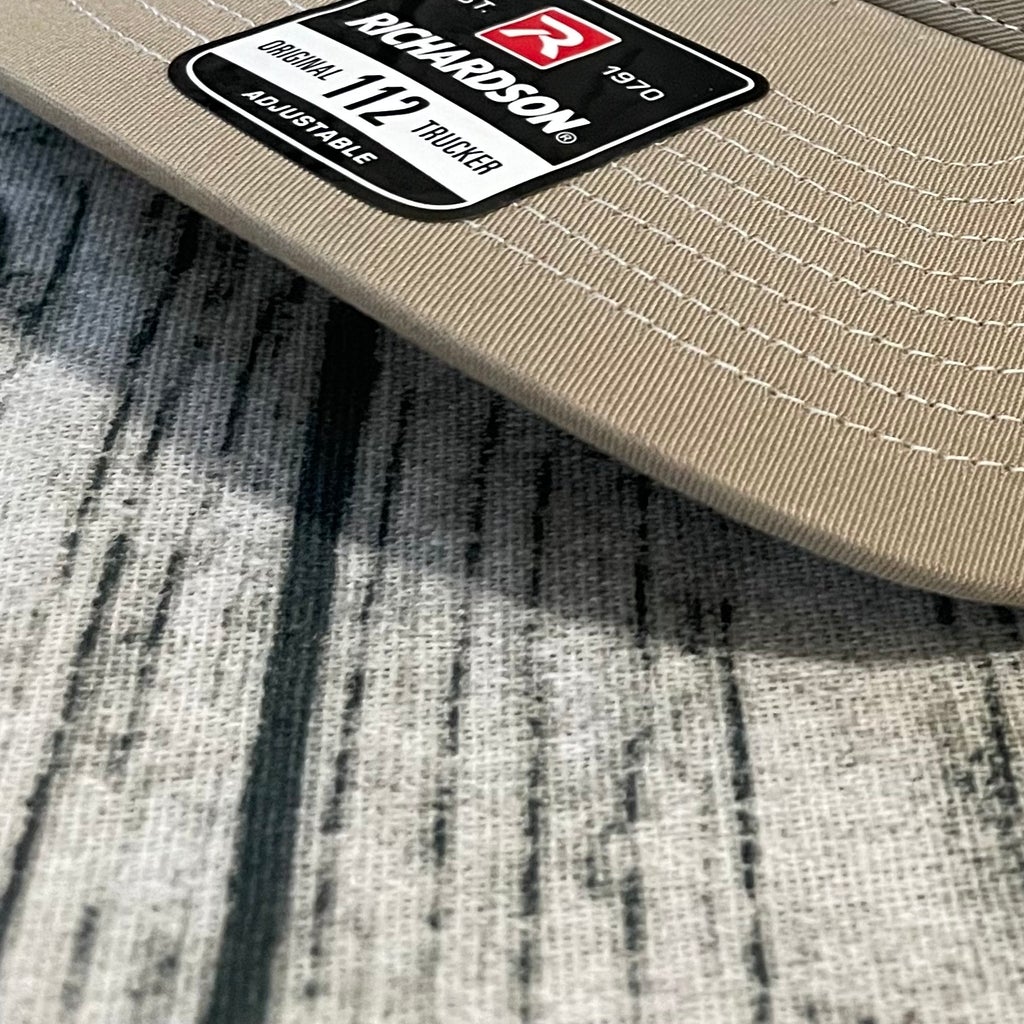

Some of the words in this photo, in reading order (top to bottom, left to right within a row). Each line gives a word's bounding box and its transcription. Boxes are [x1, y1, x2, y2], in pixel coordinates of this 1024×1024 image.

[257, 39, 344, 82] ORIGINAL
[322, 74, 431, 127] 112
[410, 119, 504, 176] TRUCKER
[602, 65, 666, 102] 1970
[241, 90, 379, 166] ADJUSTABLE
